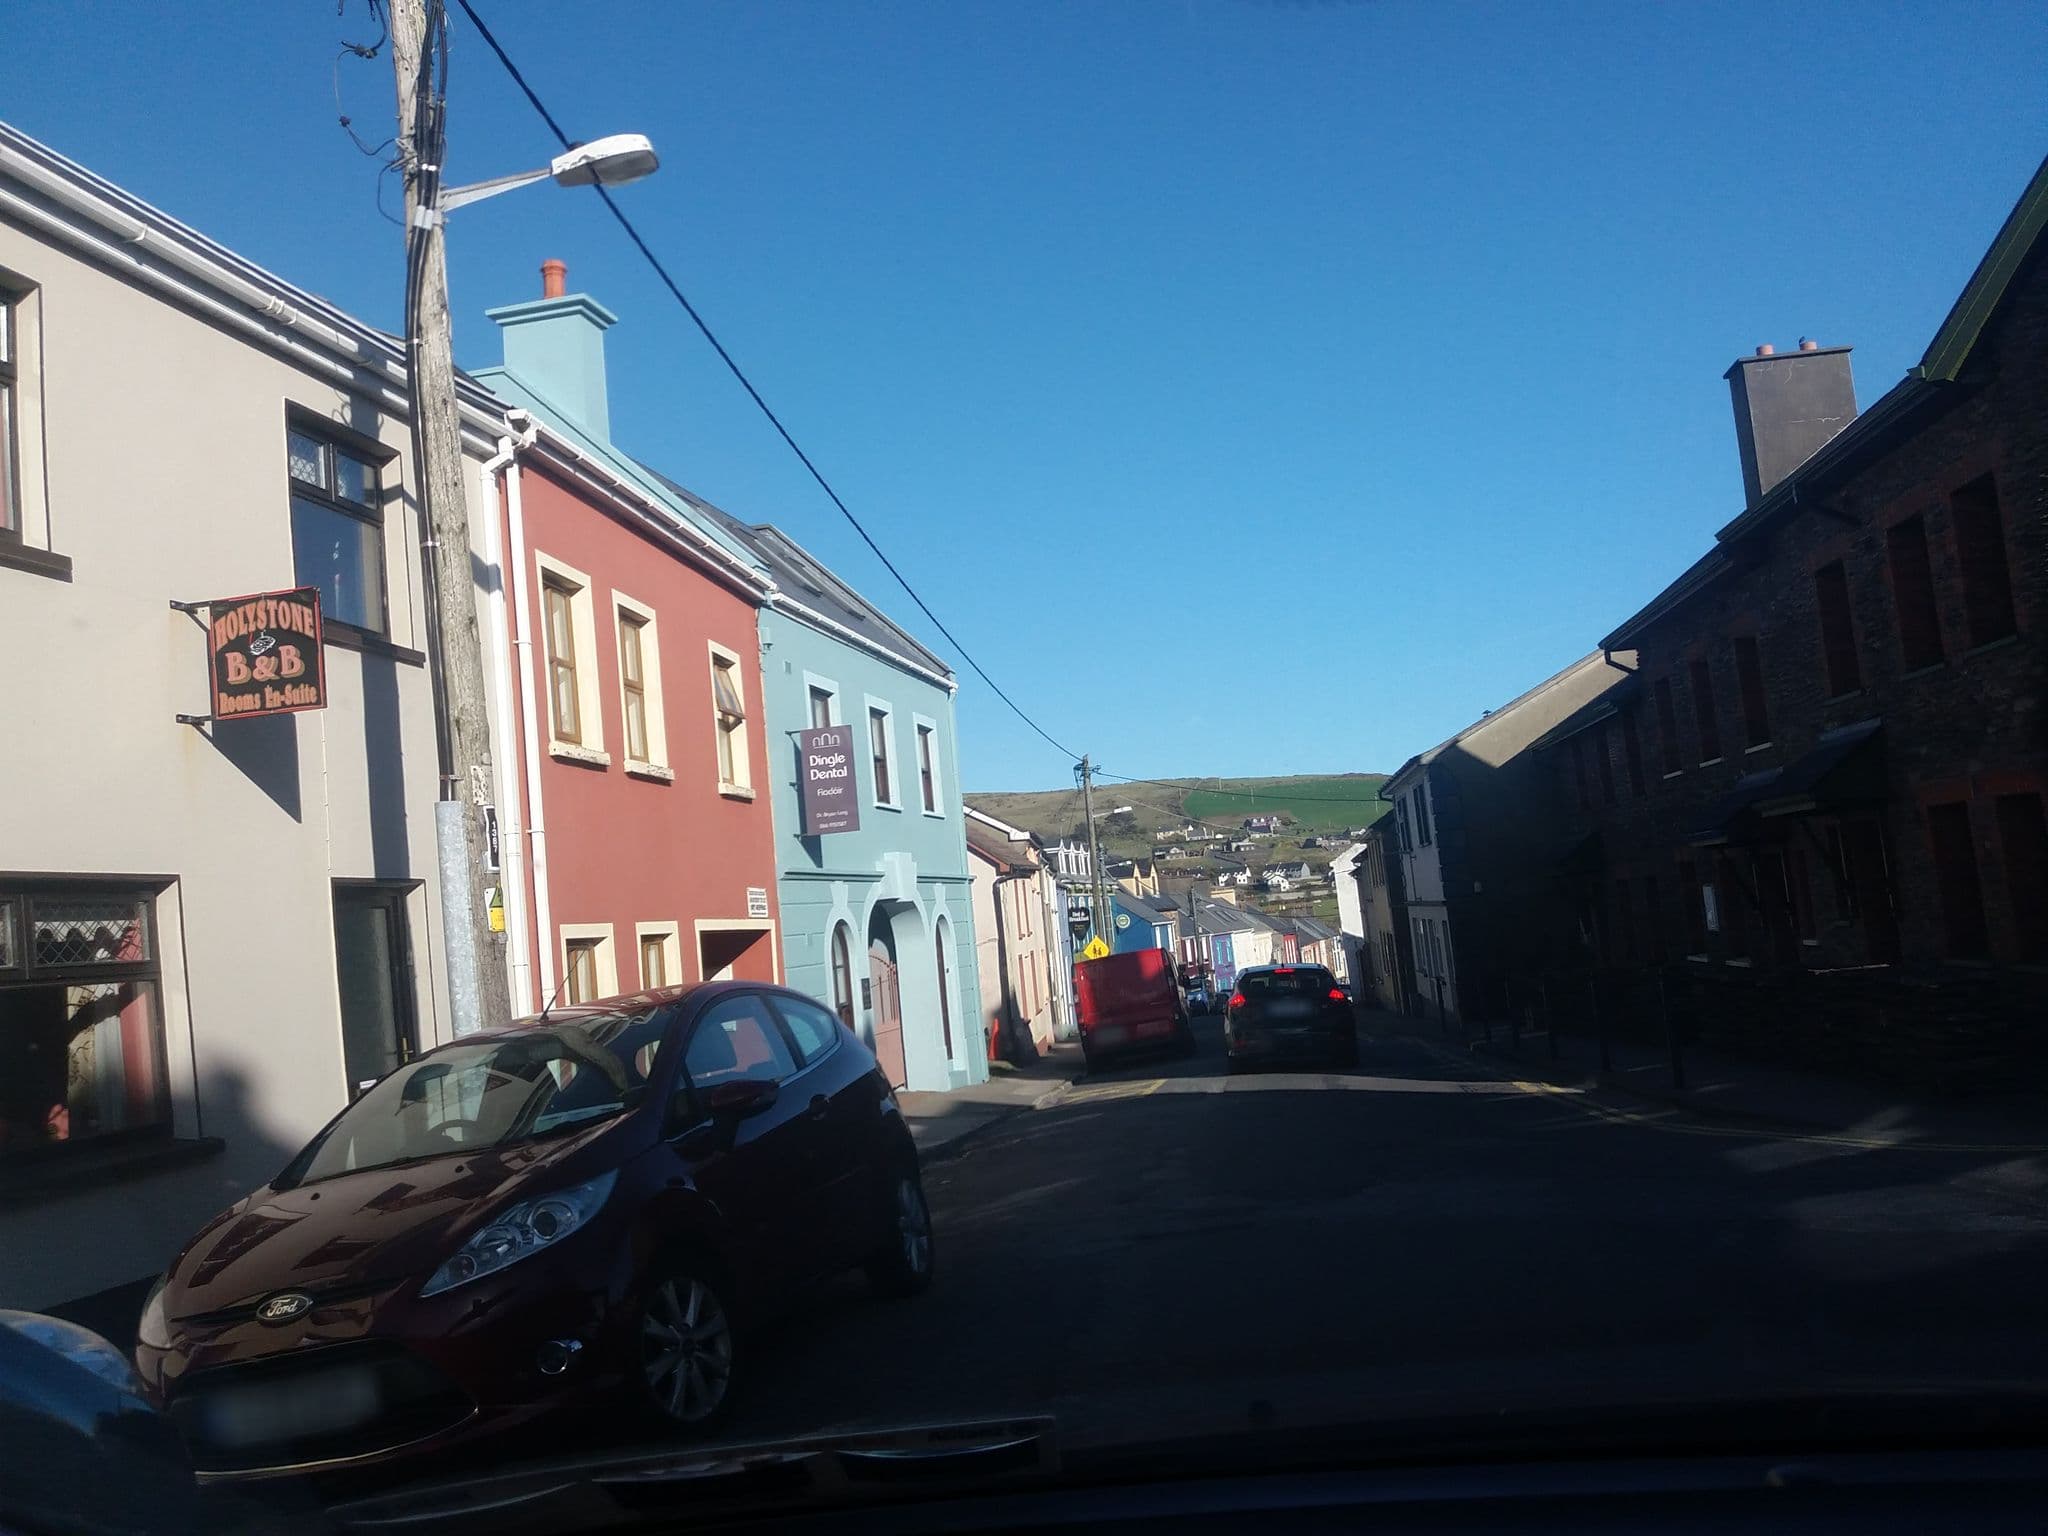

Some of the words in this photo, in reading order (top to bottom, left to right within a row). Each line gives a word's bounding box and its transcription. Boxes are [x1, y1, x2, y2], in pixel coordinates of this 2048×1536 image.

[214, 600, 315, 651] HOLYSTONE
[219, 693, 261, 713] Rooms
[809, 753, 845, 767] Dingle
[810, 767, 847, 780] Dental
[267, 1299, 299, 1316] Ford
